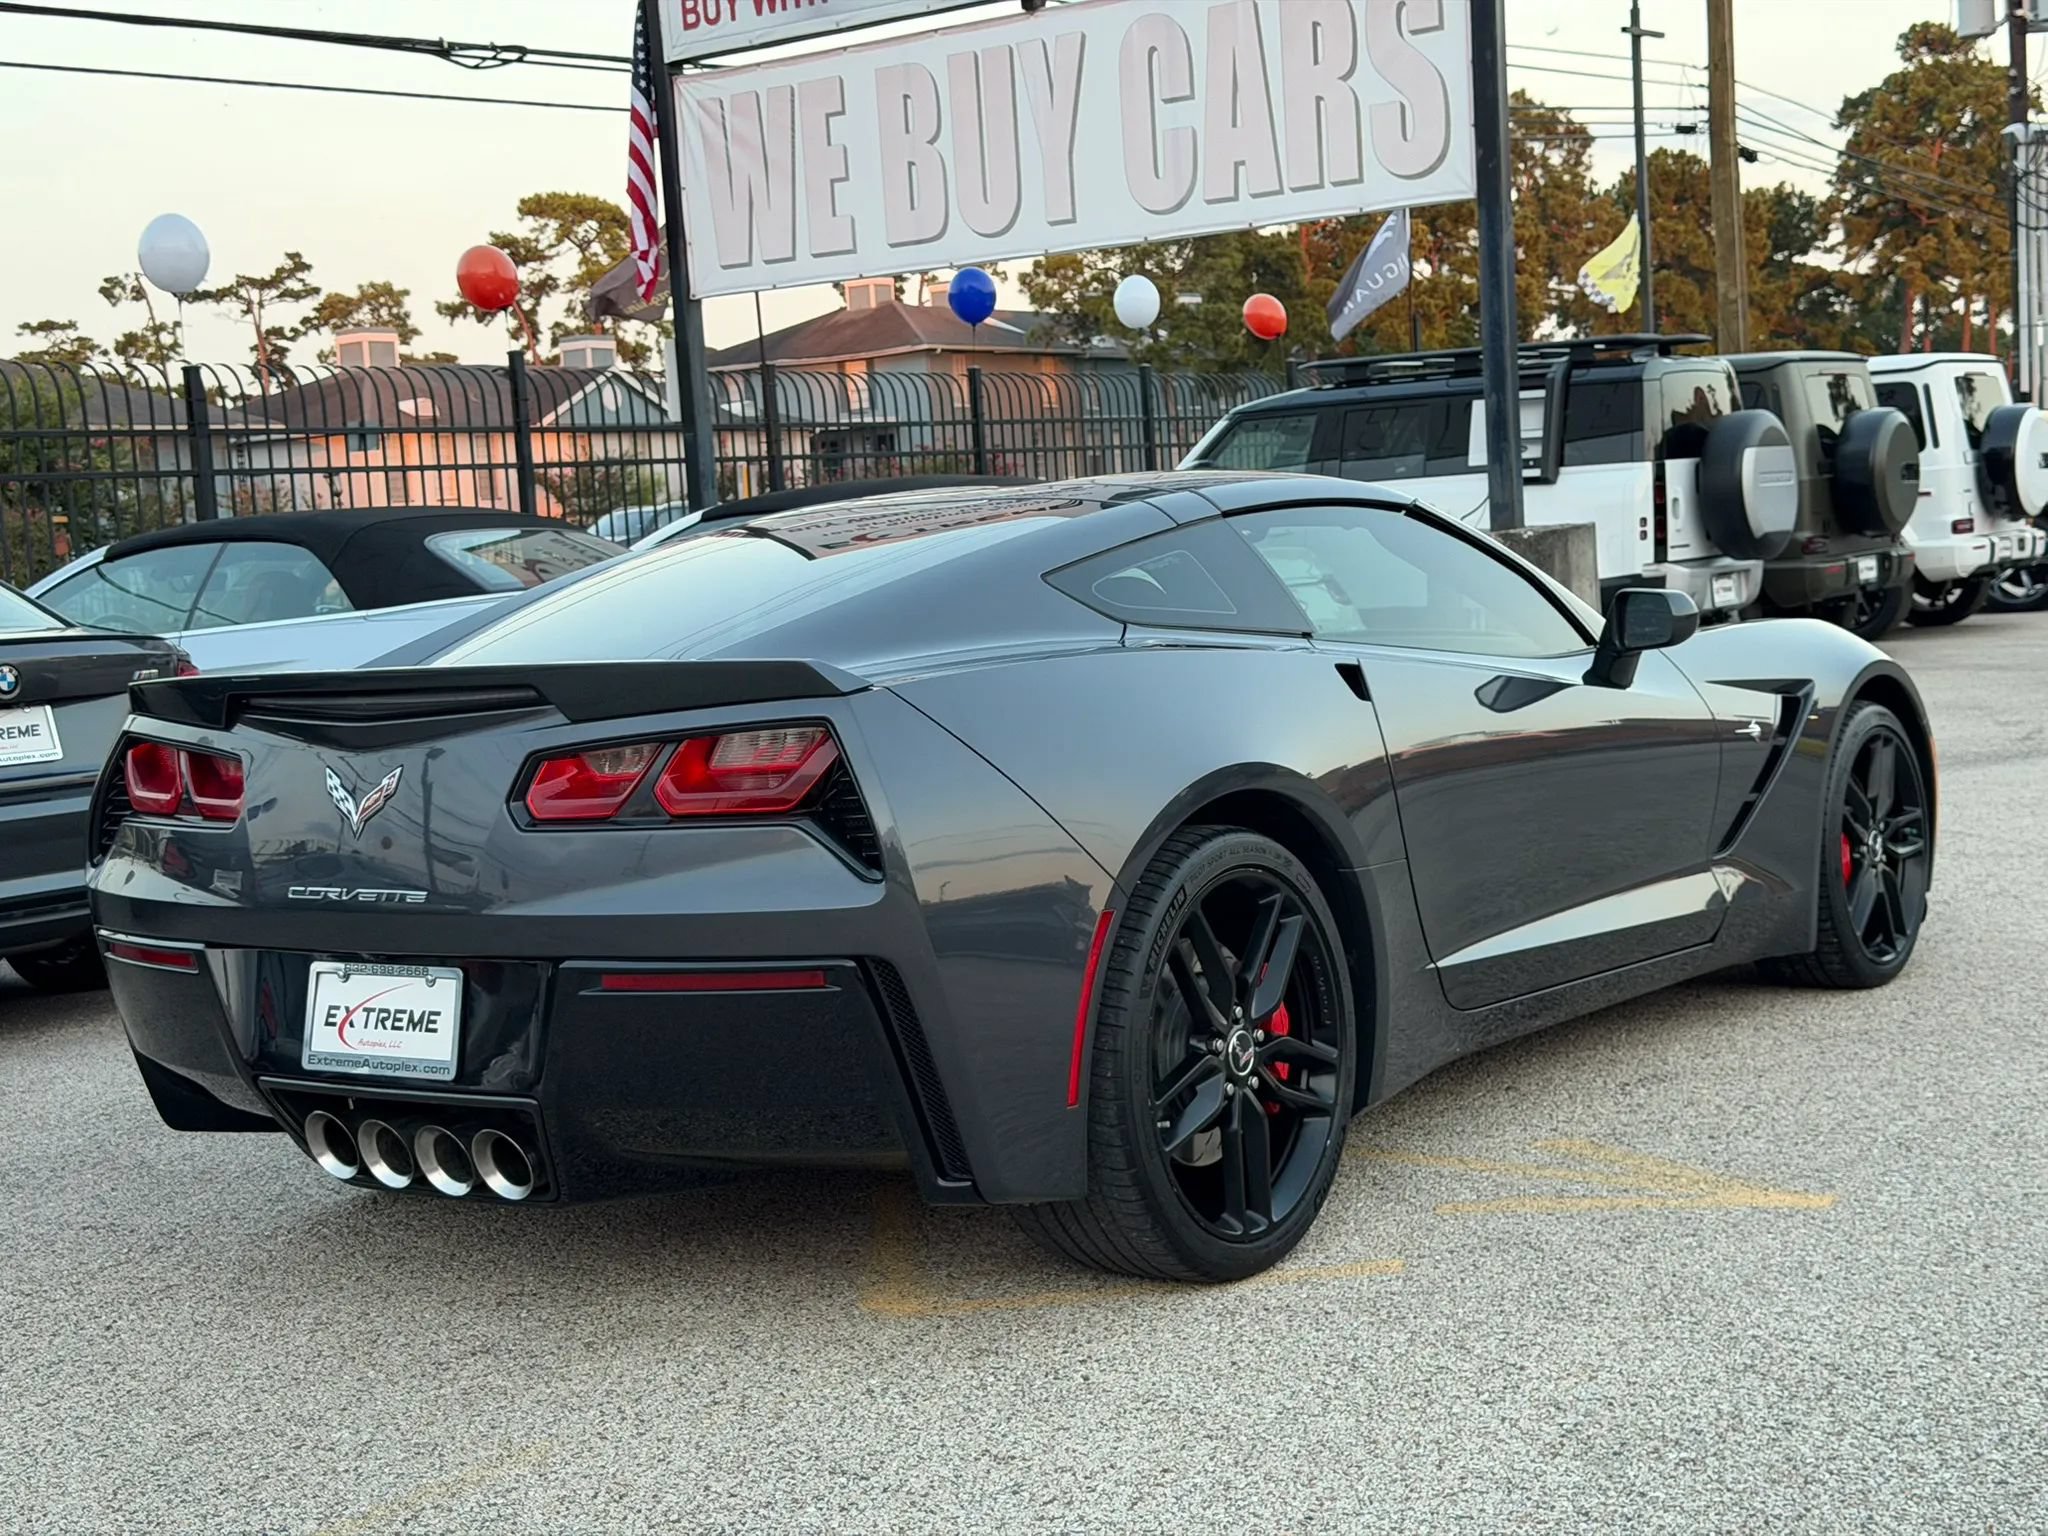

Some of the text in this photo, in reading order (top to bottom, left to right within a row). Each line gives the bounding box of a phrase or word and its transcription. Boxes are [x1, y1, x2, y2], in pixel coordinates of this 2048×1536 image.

[682, 0, 736, 31] BUY
[696, 0, 1452, 270] WE BUY CARS
[287, 886, 429, 903] CORVETTE
[323, 1004, 442, 1034] EXTREME
[307, 1053, 451, 1076] ExtremeAutoplex.com
